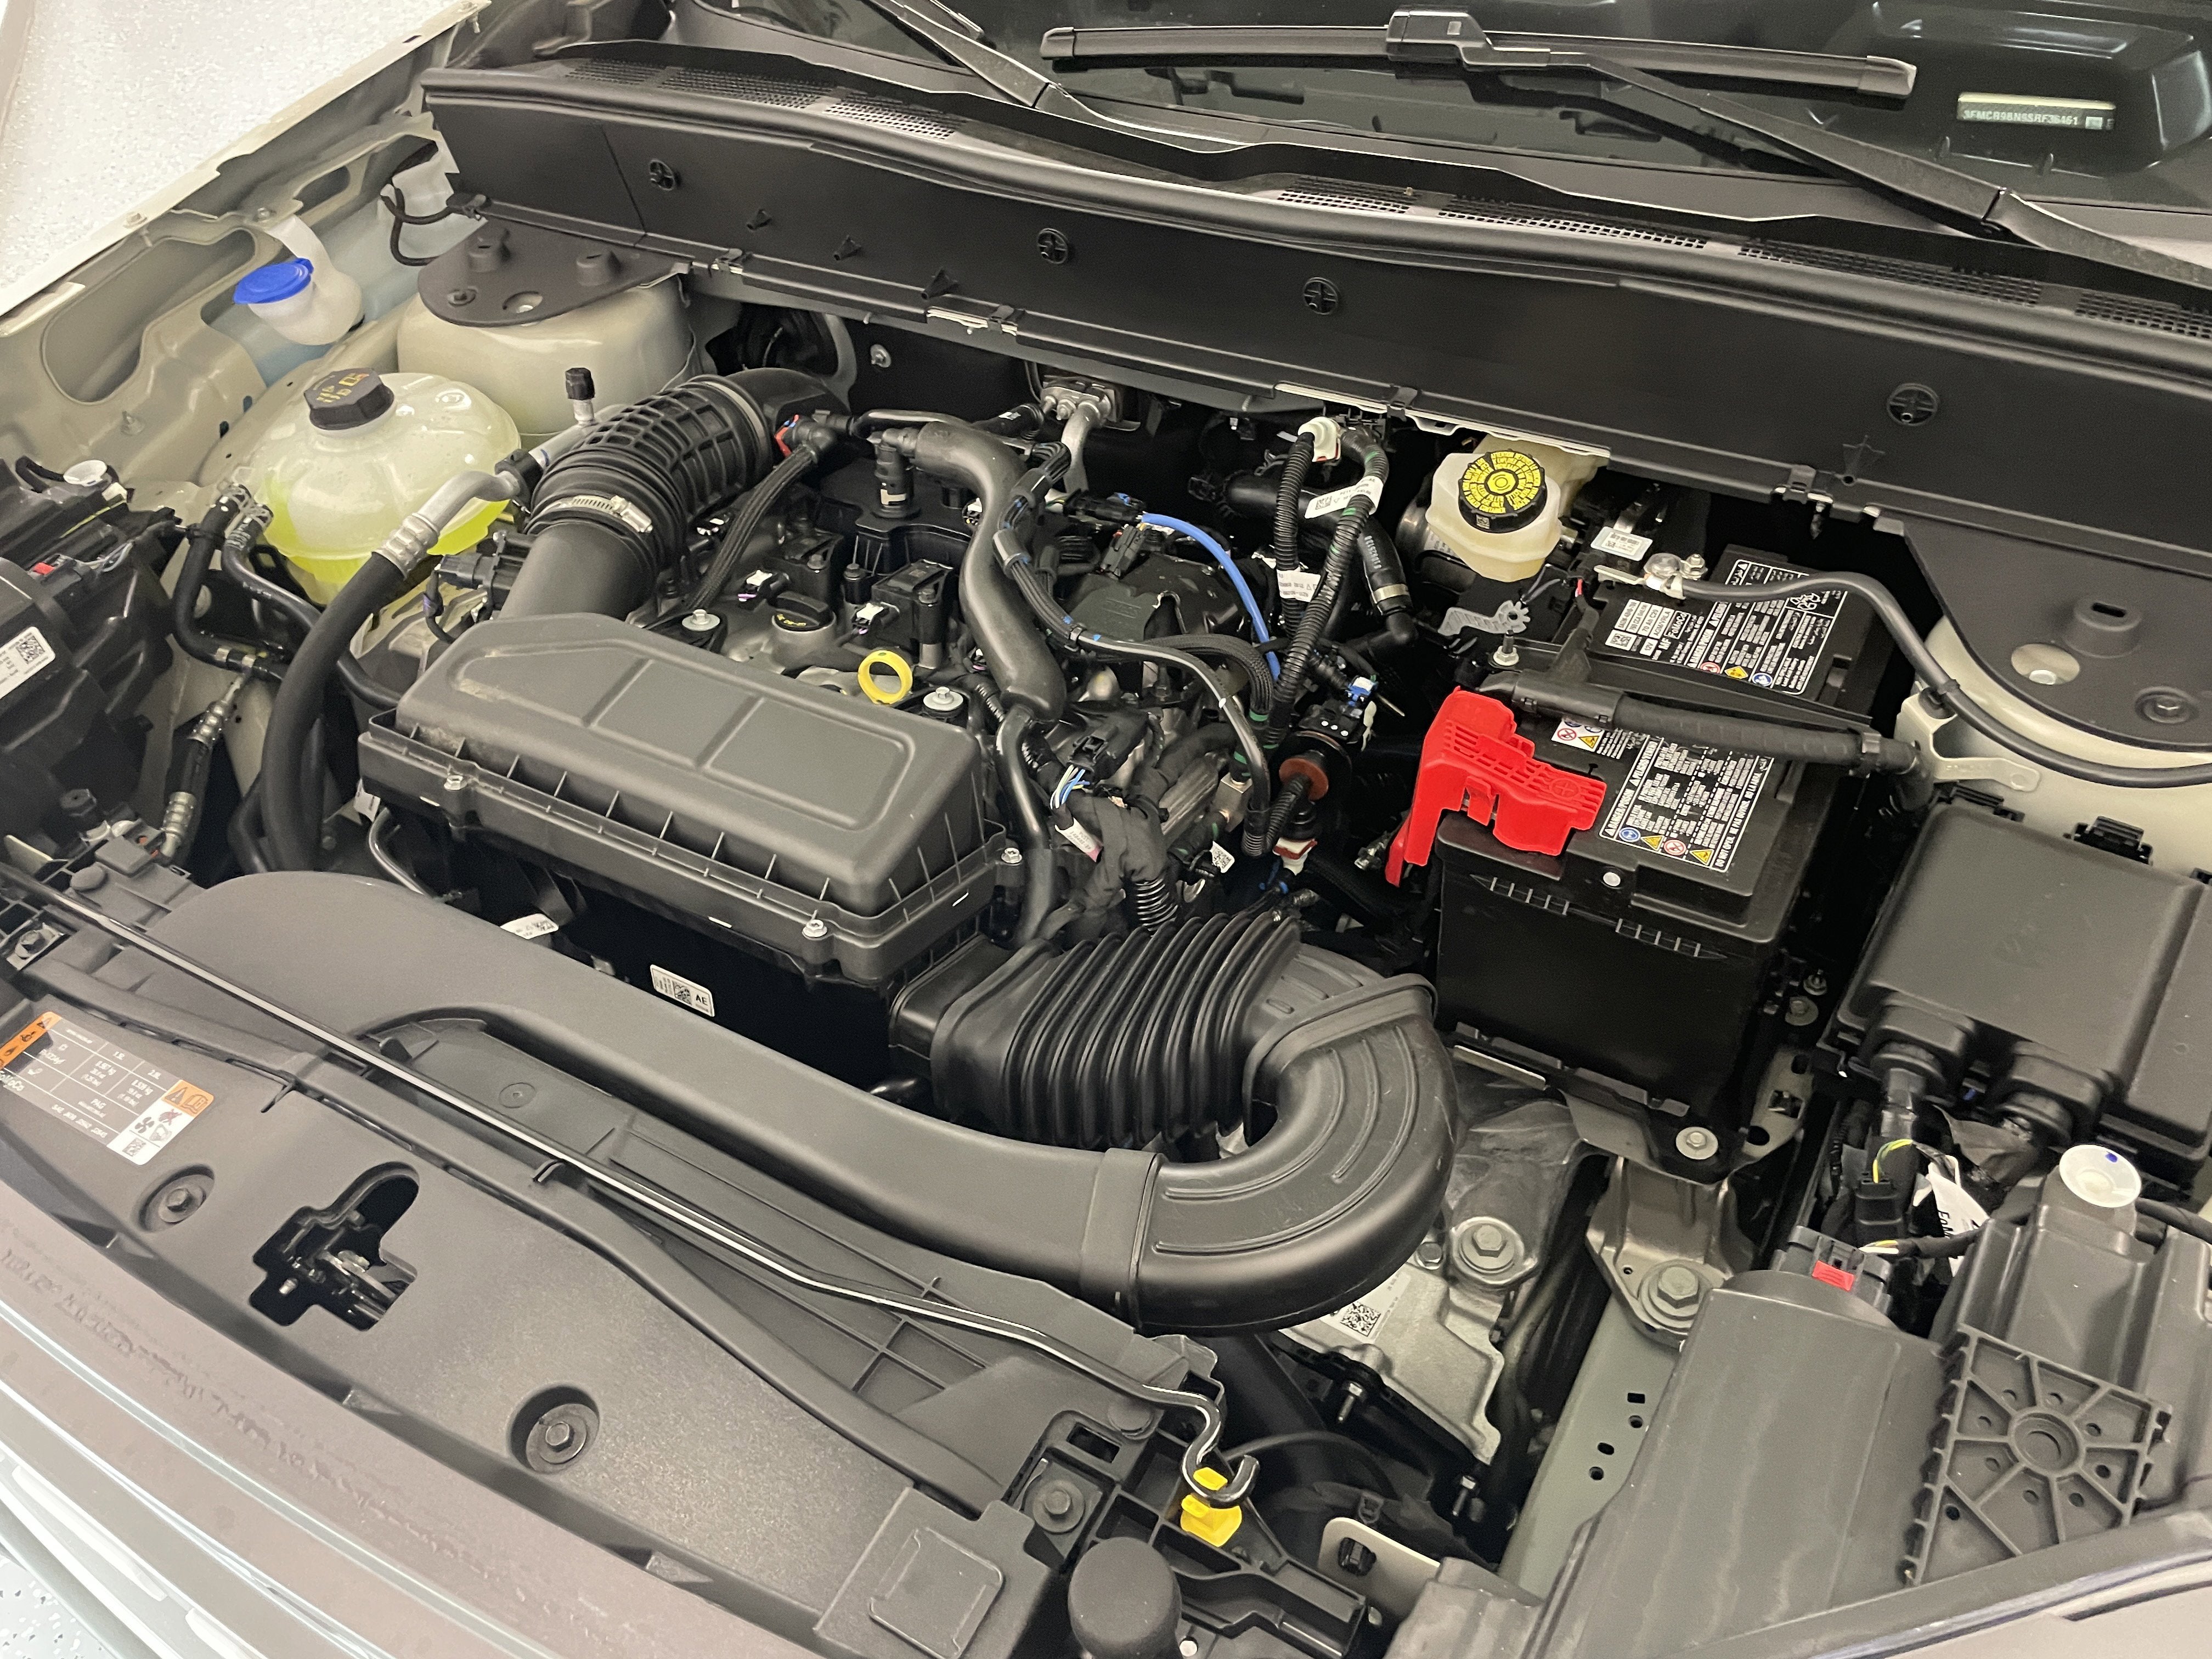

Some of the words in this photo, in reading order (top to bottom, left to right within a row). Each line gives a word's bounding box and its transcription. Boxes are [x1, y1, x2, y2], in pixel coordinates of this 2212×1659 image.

[1650, 610, 1659, 618] C20
[1654, 611, 1671, 636] AGM/VRLA
[1668, 613, 1688, 639] FoMoCo
[1645, 642, 1654, 651] 12V
[1658, 637, 1671, 650] MF
[696, 994, 708, 1006] AE
[91, 1098, 107, 1109] PAG
